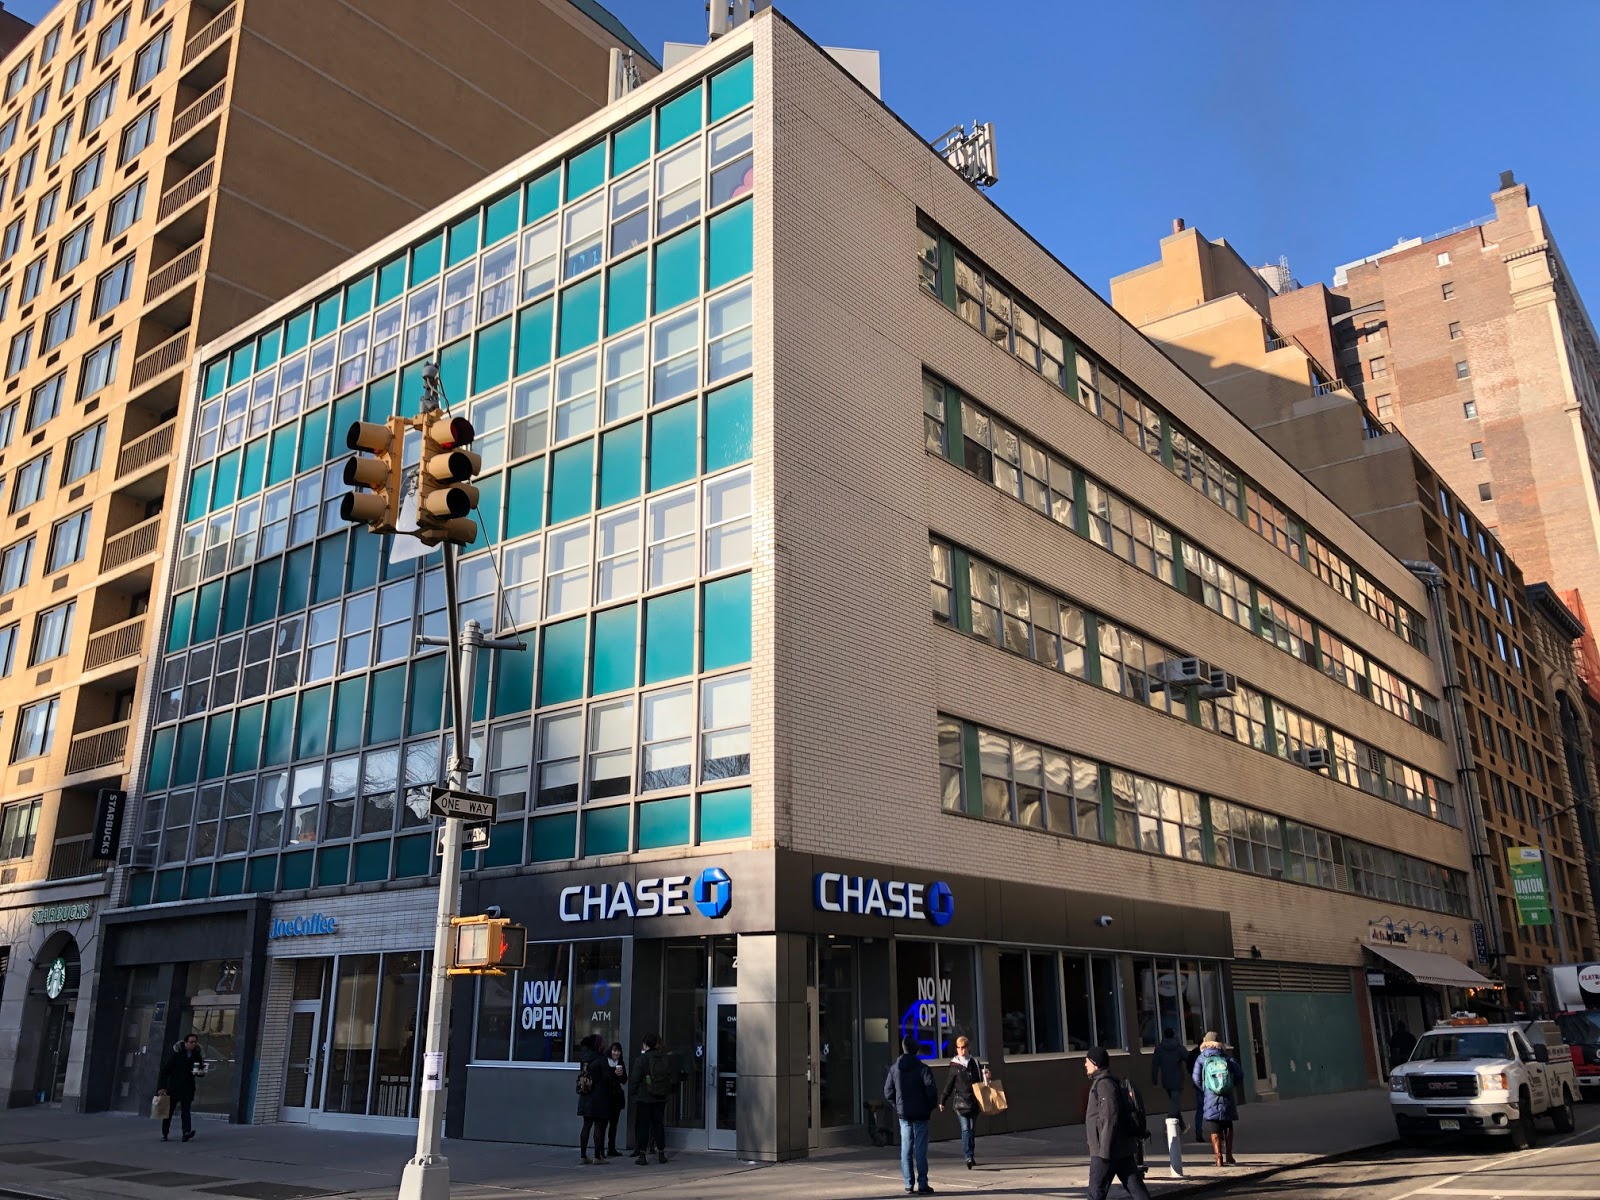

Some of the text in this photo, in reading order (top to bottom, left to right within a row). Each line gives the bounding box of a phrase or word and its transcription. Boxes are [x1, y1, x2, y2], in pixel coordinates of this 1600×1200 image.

[441, 797, 489, 815] ONE WAY
[101, 793, 118, 855] STARBUCKS
[466, 827, 484, 841] WAY
[817, 871, 926, 920] CHASE
[1514, 878, 1544, 894] UNION
[559, 875, 688, 922] CHASE
[30, 903, 90, 926] STARBUCKS
[522, 980, 562, 1004] NOW
[917, 976, 951, 1002] NOW
[521, 1006, 564, 1030] OPEN
[591, 1010, 611, 1021] ATM
[918, 1003, 955, 1027] OPEN
[1428, 1081, 1457, 1090] GMC
